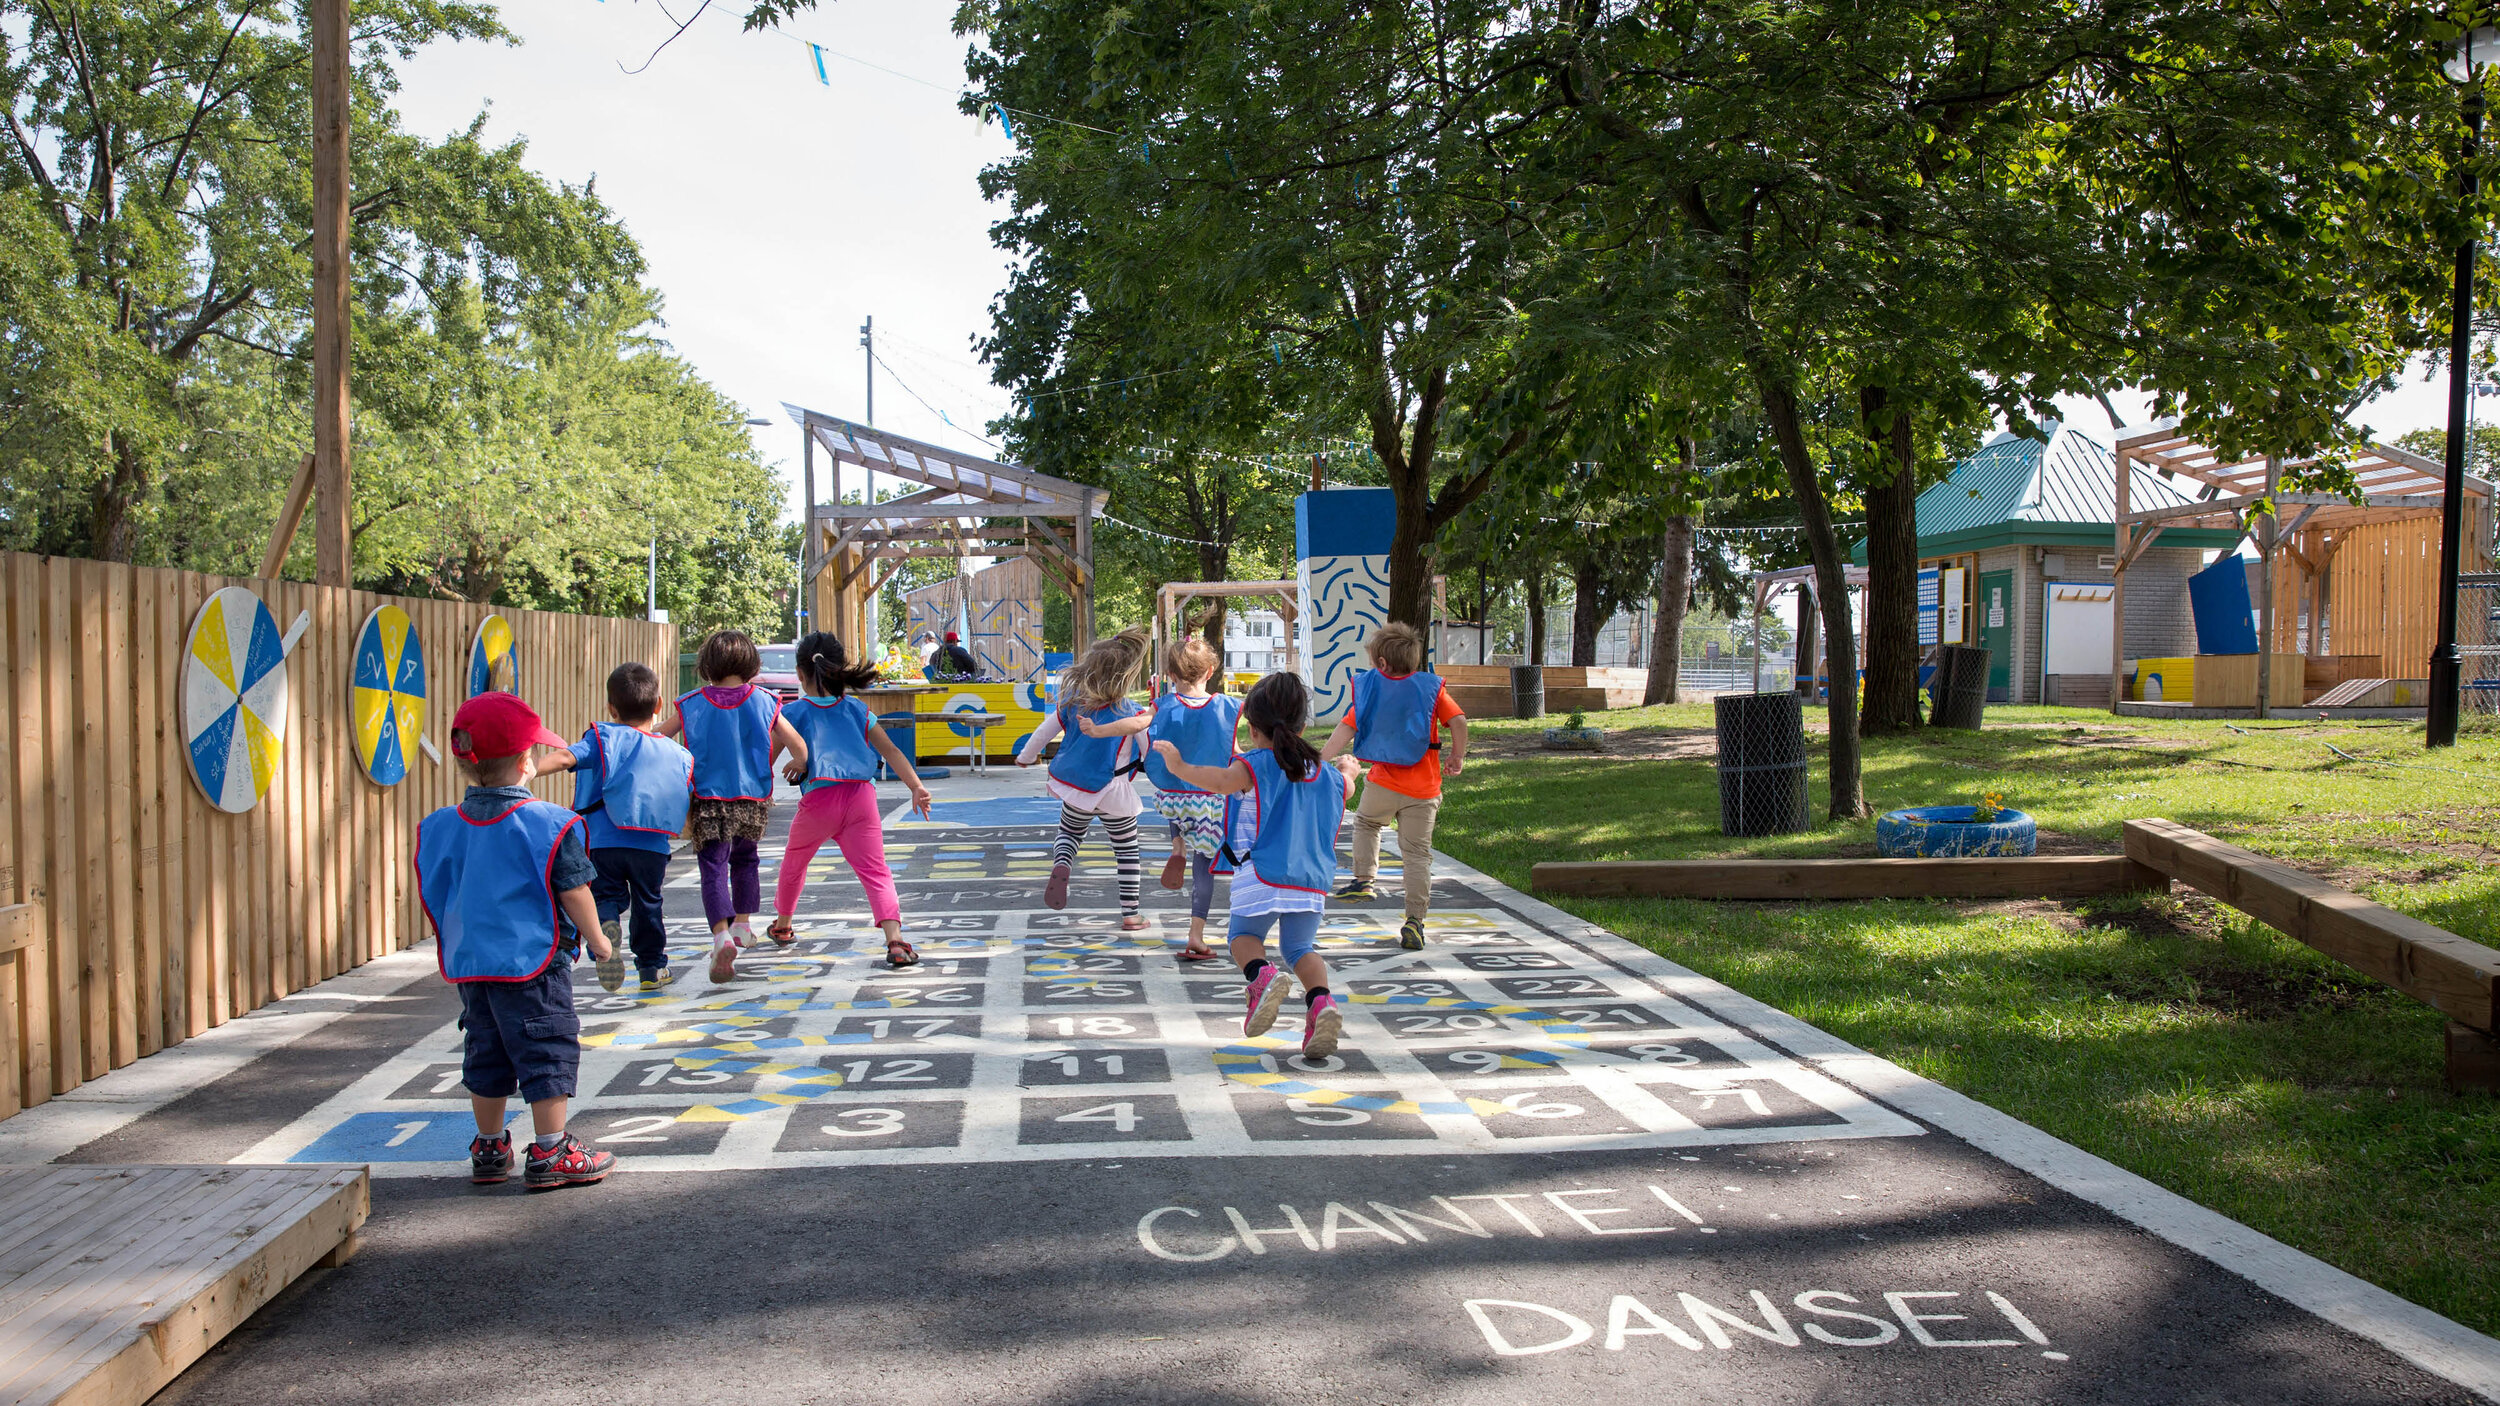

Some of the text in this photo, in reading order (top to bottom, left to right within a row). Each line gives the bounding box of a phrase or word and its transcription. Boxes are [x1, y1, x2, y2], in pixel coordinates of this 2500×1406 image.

[387, 625, 398, 661] 3
[366, 652, 382, 680] 2
[402, 659, 417, 684] 4
[365, 708, 380, 729] 1
[400, 705, 415, 734] 5
[912, 918, 984, 929] 45
[1035, 915, 1117, 926] 46
[1045, 935, 1120, 947] 39
[1474, 955, 1562, 968] 35
[882, 987, 974, 1001] 26
[1044, 983, 1135, 997] 25
[1367, 983, 1454, 997] 23
[1508, 979, 1608, 994] 22
[864, 1019, 955, 1038] 17
[1047, 1017, 1138, 1036] 18
[1396, 1015, 1497, 1033] 20
[1558, 1009, 1649, 1026] 21
[1046, 1054, 1125, 1077] 11
[1260, 1053, 1346, 1073] 10
[1448, 1050, 1501, 1074] 9
[1628, 1044, 1700, 1067] 8
[842, 1059, 939, 1083] 12
[1286, 1098, 1372, 1127] 5
[1501, 1091, 1586, 1119] 6
[594, 1115, 679, 1142] 2
[820, 1108, 906, 1138] 3
[1054, 1102, 1145, 1133] 4
[385, 1121, 432, 1147] 1
[1137, 1184, 1720, 1263] CHANTE!
[1462, 1288, 2070, 1362] DANSE!
